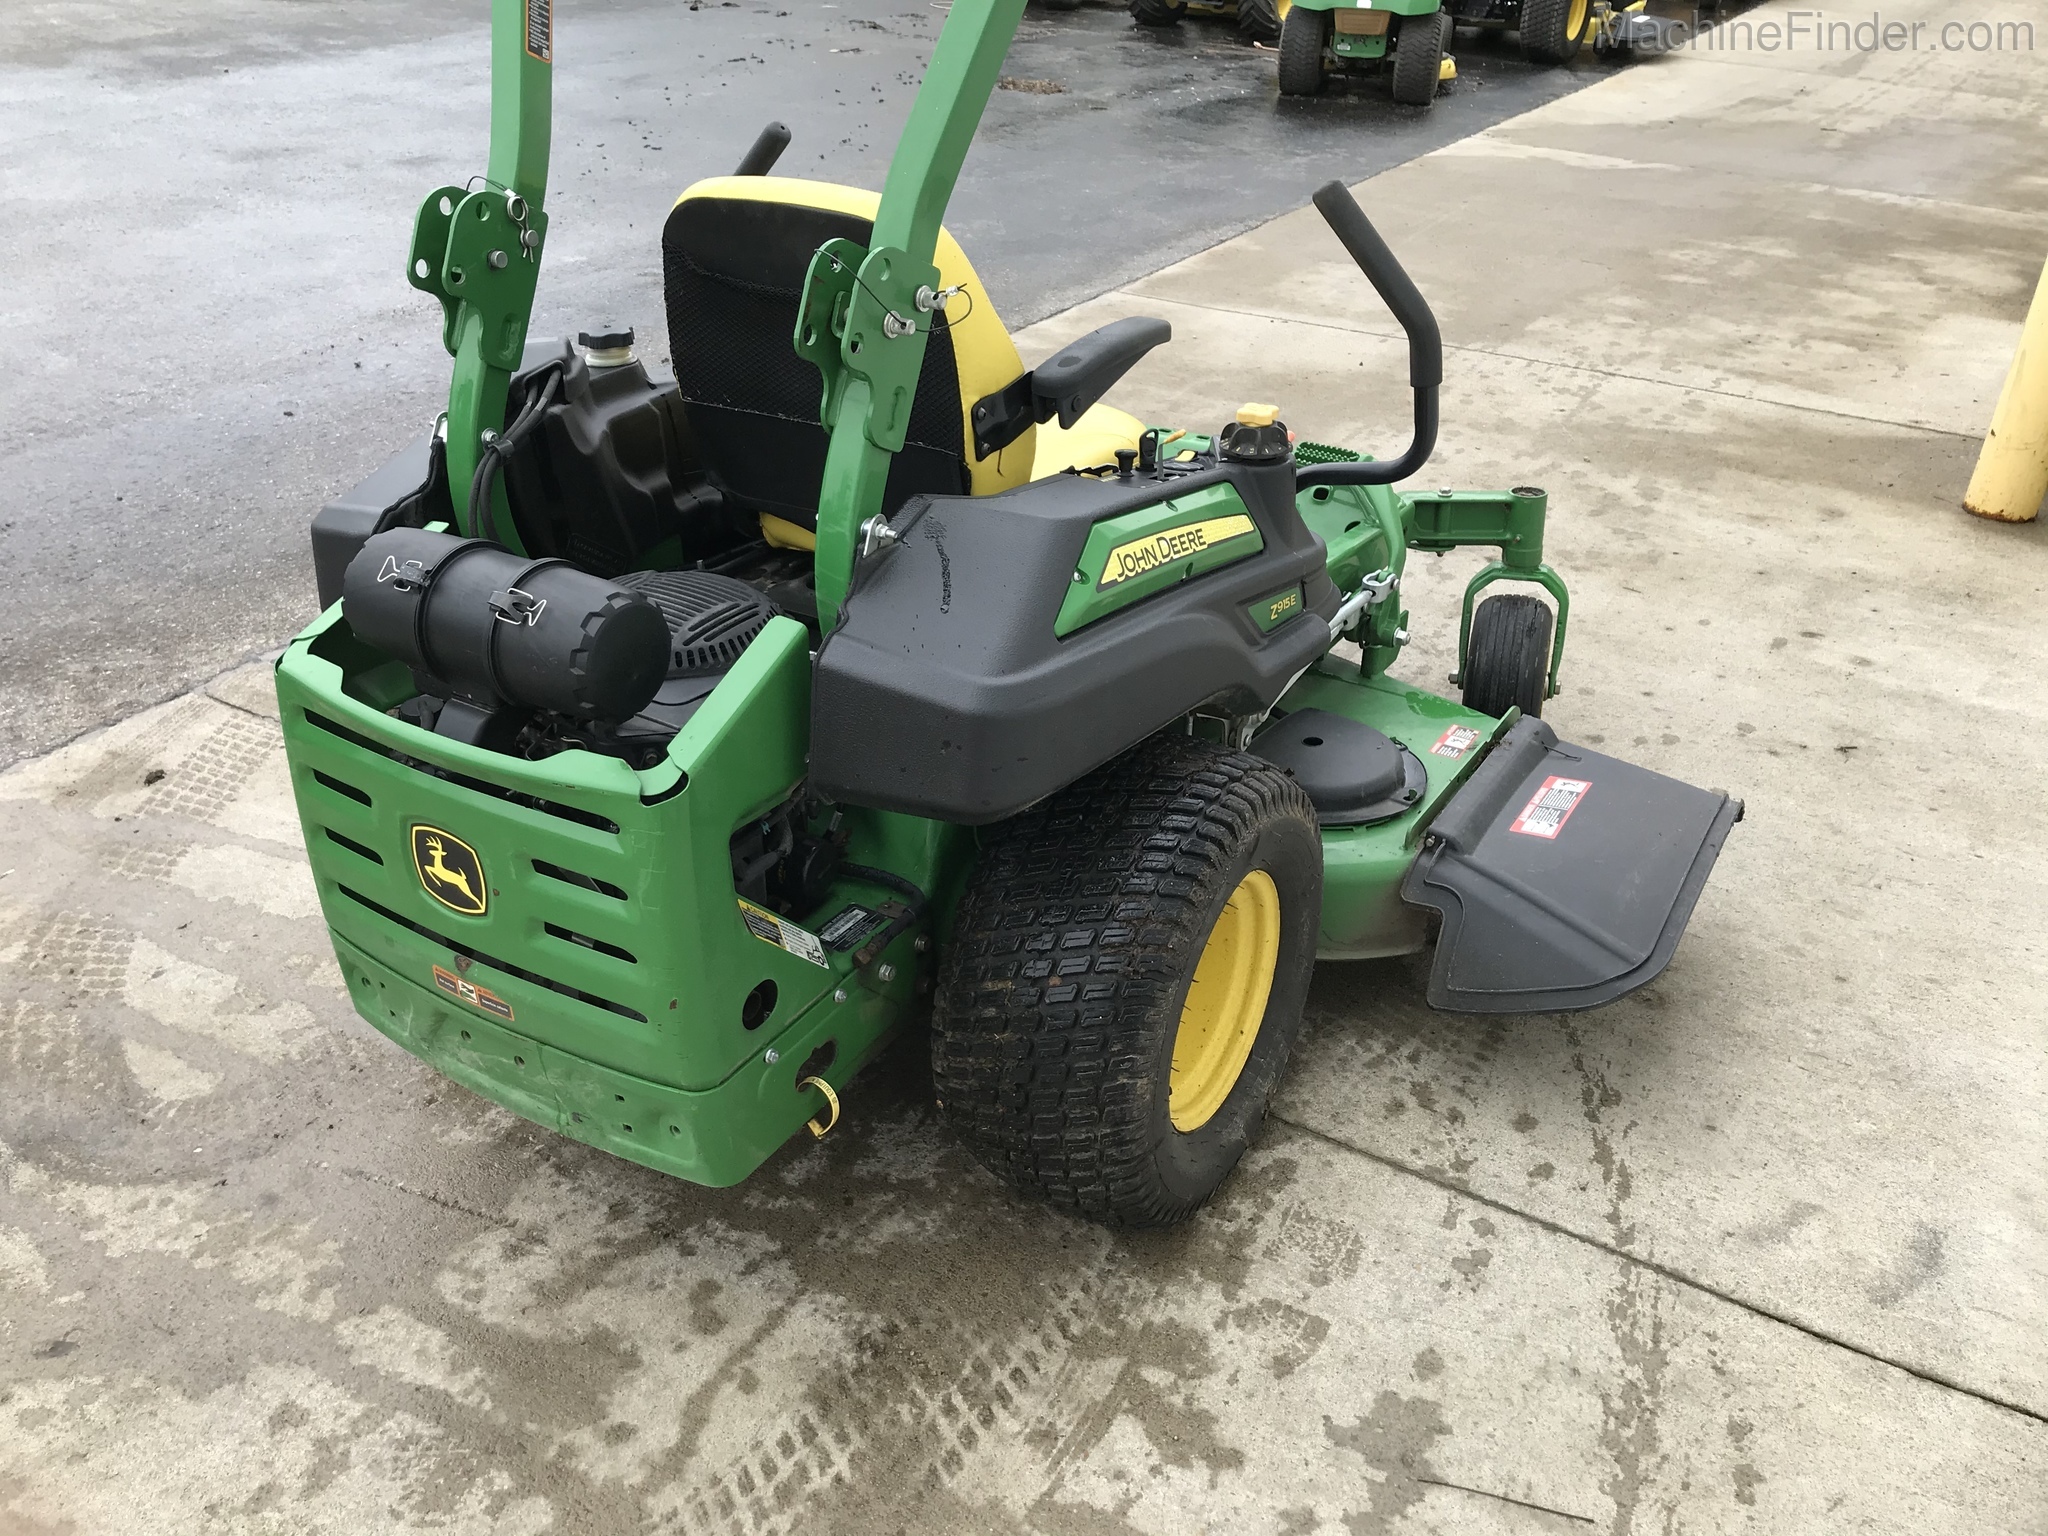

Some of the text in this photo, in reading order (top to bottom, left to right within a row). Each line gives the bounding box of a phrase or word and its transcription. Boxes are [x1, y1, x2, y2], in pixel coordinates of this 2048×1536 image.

[1116, 528, 1207, 577] JOHN DEERE
[1270, 593, 1297, 620] Z915E
